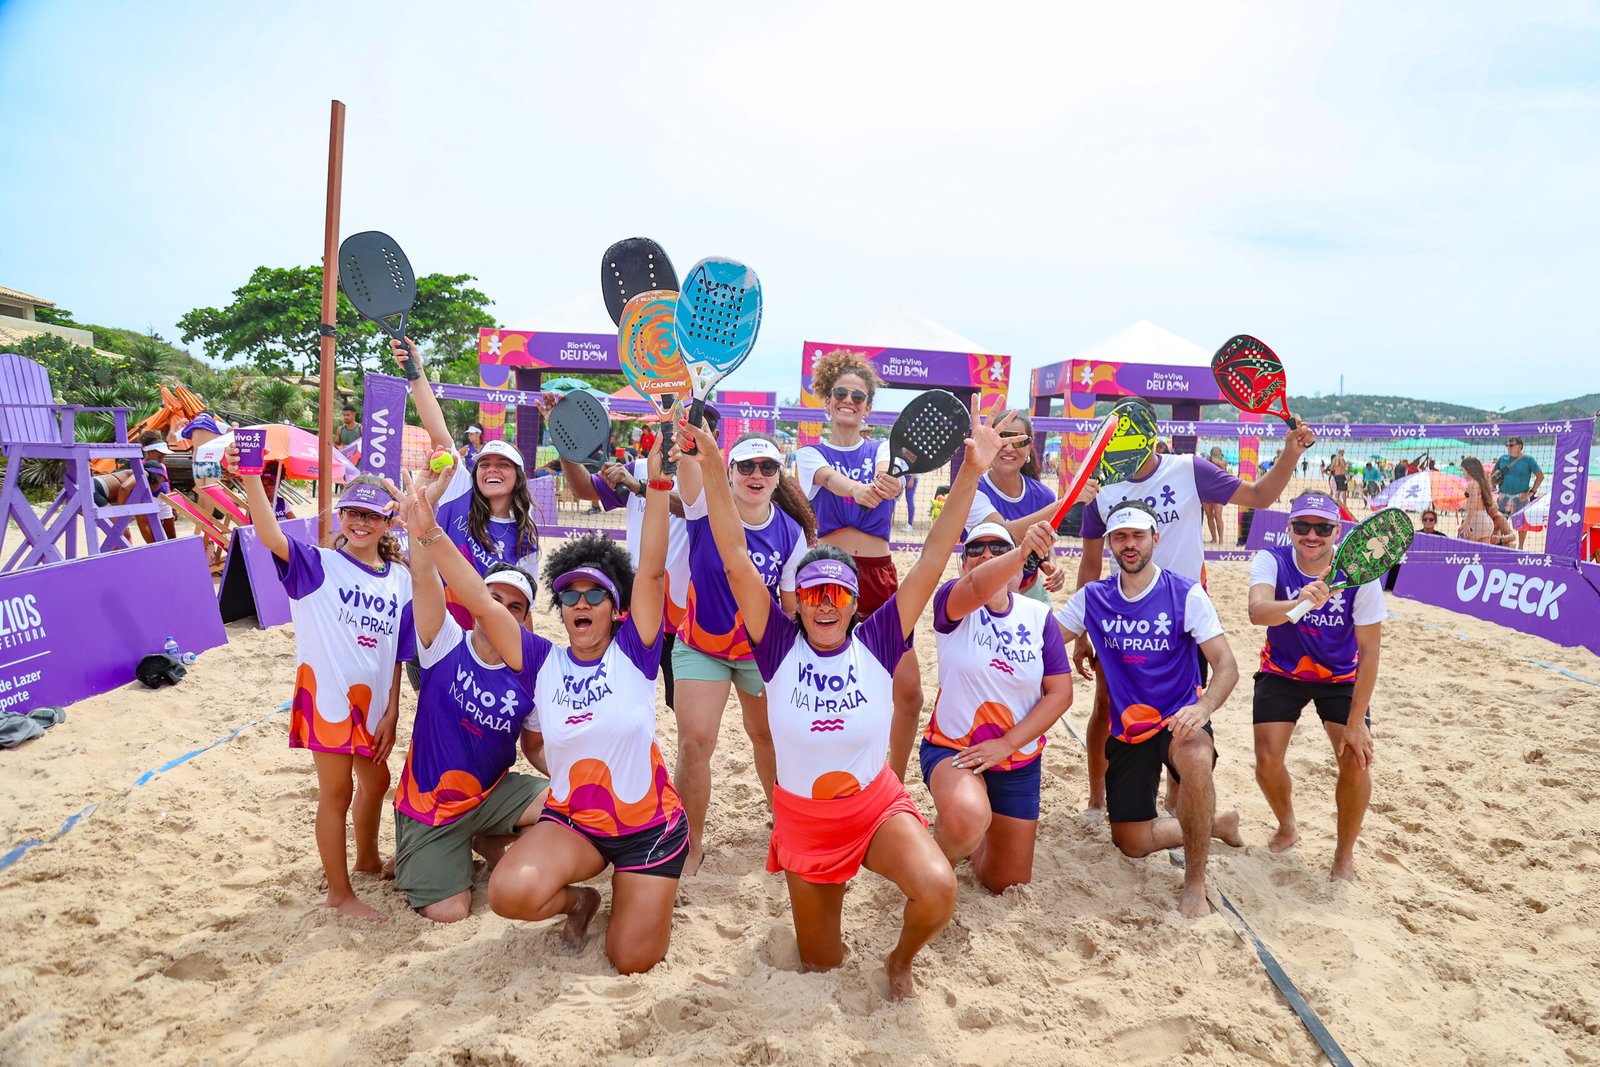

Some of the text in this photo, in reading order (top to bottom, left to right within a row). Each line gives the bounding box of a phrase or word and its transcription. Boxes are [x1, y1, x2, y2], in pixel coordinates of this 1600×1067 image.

[567, 341, 601, 350] Rio+Vivo
[1217, 338, 1243, 366] ULTRA
[560, 350, 608, 361] DEU BOM
[882, 364, 928, 378] DEU BOM
[1146, 380, 1189, 392] DEU BOM
[487, 391, 515, 403] vivo
[740, 407, 769, 418] vivo
[1076, 421, 1100, 432] viv
[1158, 423, 1185, 434] vivo
[1237, 424, 1264, 435] vivo
[1314, 425, 1341, 436] vivo
[1391, 426, 1416, 437] vivo
[1464, 425, 1490, 436] vivo
[1537, 423, 1562, 434] vivo
[371, 408, 395, 468] vivo
[831, 461, 861, 480] ivo
[1560, 448, 1584, 505] vivo
[453, 515, 469, 537] NA
[1061, 548, 1084, 557] viv
[1219, 552, 1246, 561] vivo
[1445, 554, 1470, 565] vivo
[1517, 555, 1542, 566] vivo
[338, 584, 386, 613] vivo
[338, 608, 358, 628] NA
[1101, 614, 1150, 634] vivo
[1303, 611, 1345, 627] PRAIA
[973, 630, 992, 650] NA
[1104, 636, 1170, 651] NA PRAIA
[13, 670, 41, 687] Lazer
[799, 662, 844, 692] vivo
[457, 664, 496, 708] vivo
[552, 688, 570, 708] NA
[790, 687, 868, 713] NA PRAIA
[449, 681, 511, 733] NA PRAIA
